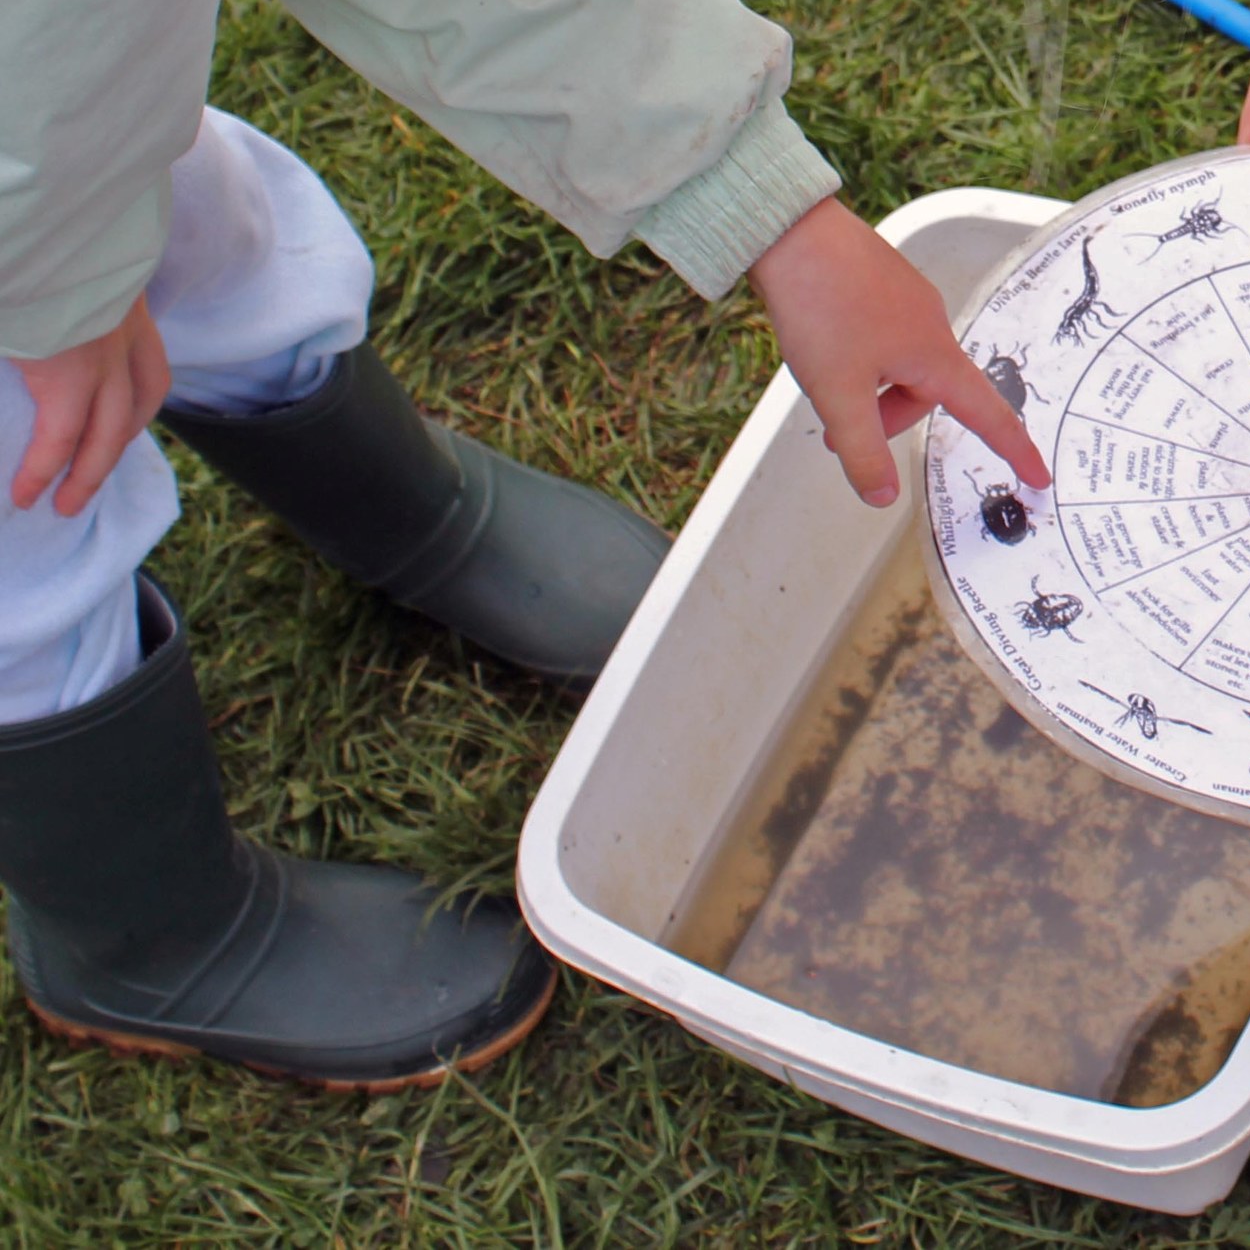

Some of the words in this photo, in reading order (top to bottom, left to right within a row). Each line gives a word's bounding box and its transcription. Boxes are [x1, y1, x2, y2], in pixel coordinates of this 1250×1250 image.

[1168, 170, 1216, 193] nymph
[988, 279, 1031, 312] Diving
[1024, 249, 1060, 279] Beetle
[1057, 224, 1088, 249] larva
[930, 456, 947, 493] Beetle
[937, 495, 958, 556] Whirligig
[1201, 568, 1219, 585] fast
[1219, 551, 1242, 573] water
[956, 576, 986, 613] Beetle
[1180, 566, 1221, 601] swimmer
[1124, 589, 1150, 613] along
[1148, 611, 1188, 646] abdomen
[1140, 586, 1160, 605] look
[1159, 604, 1174, 617] for
[1170, 616, 1191, 634] gills
[983, 611, 1017, 656] Diving
[1211, 637, 1245, 655] makes
[1012, 656, 1042, 691] Great
[1056, 701, 1104, 735] Boatman
[1105, 731, 1139, 756] Water
[1143, 753, 1187, 782] Greater
